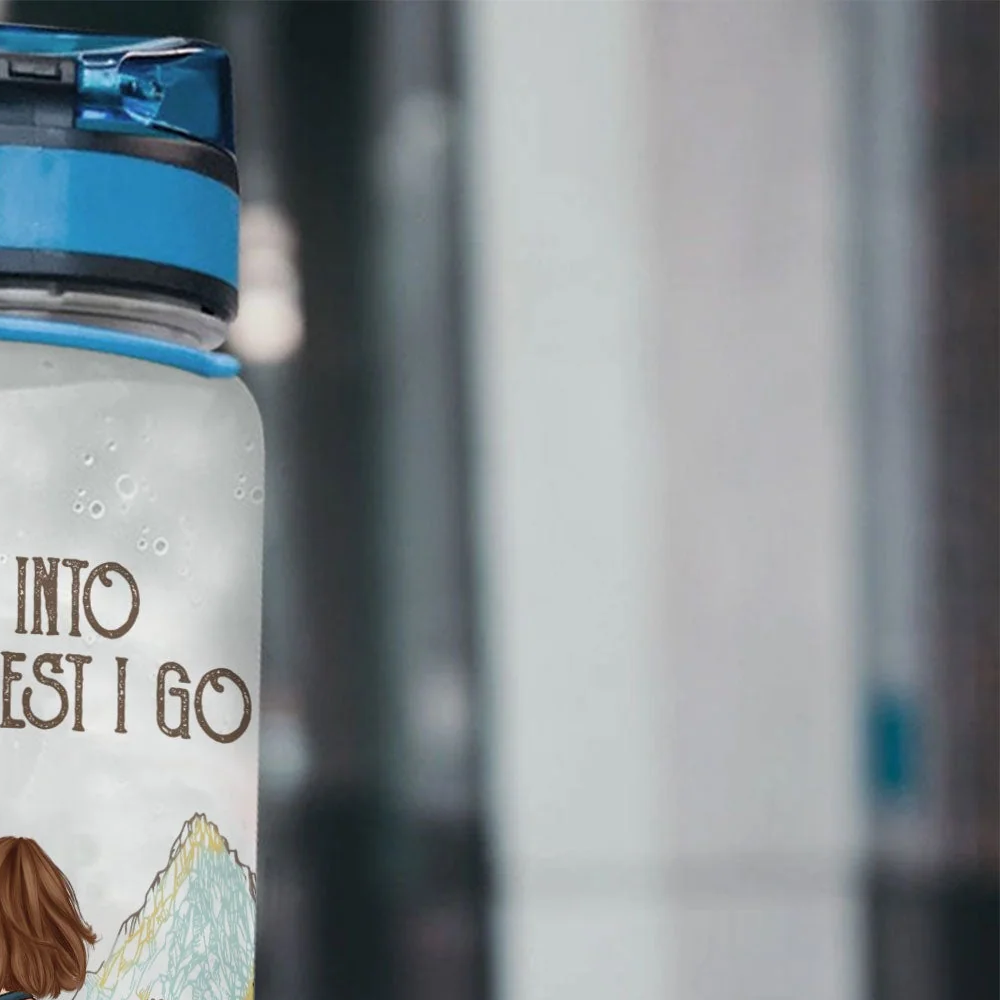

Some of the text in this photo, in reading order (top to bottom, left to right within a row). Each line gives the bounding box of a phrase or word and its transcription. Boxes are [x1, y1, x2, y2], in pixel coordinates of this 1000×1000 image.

[14, 556, 140, 639] INTO
[114, 656, 128, 734] I
[156, 661, 252, 744] GO
